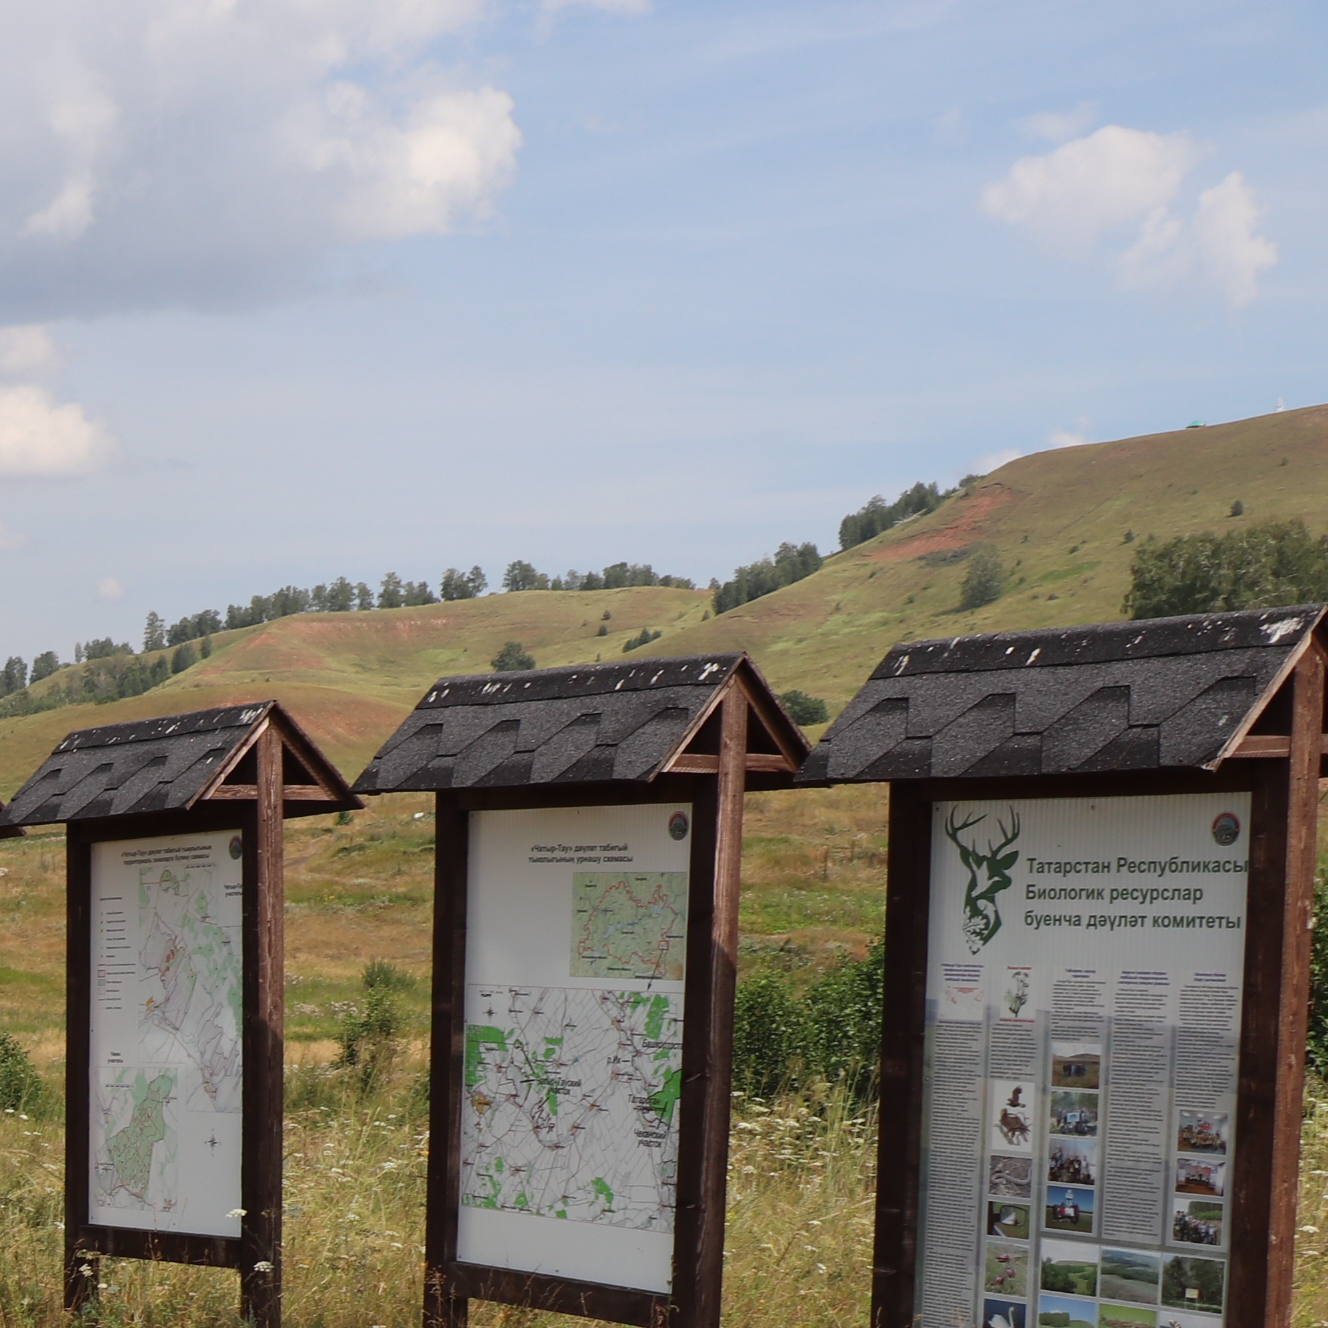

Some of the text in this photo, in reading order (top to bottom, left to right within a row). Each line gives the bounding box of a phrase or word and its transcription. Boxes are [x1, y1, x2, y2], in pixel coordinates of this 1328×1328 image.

[1026, 856, 1249, 877] Татарстан Республикасы
[1025, 884, 1204, 904] Биологик ресурслар
[1024, 910, 1241, 931] буенча дәүләт комитеты
